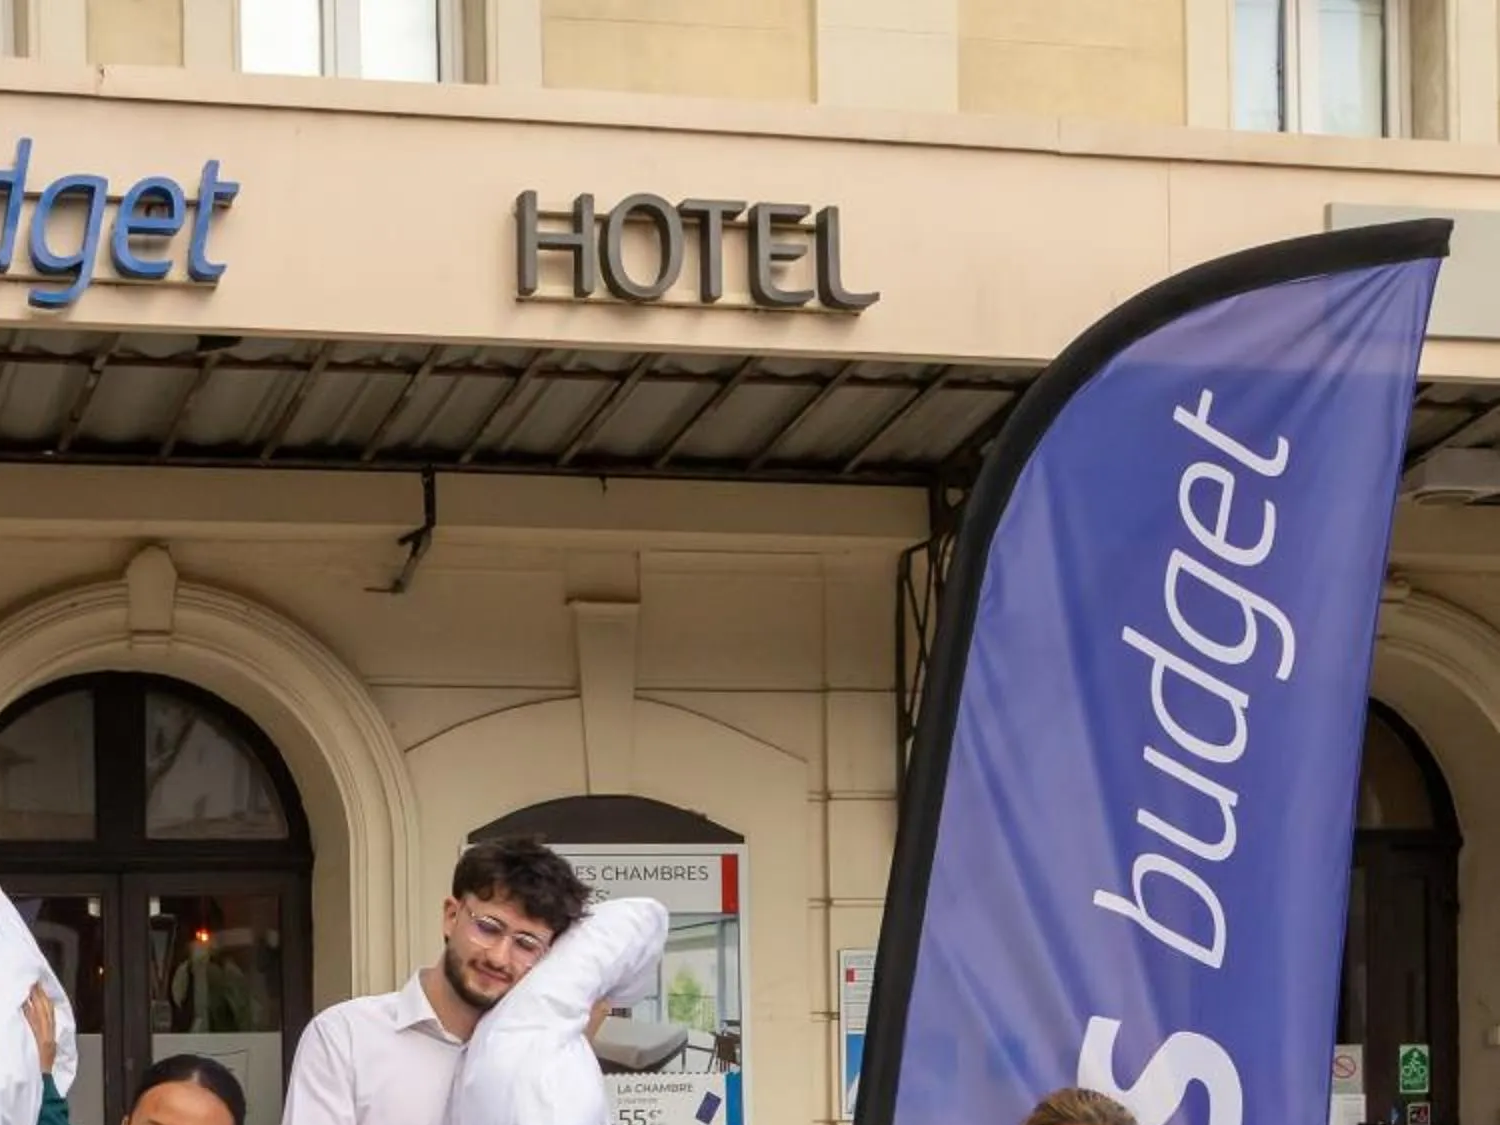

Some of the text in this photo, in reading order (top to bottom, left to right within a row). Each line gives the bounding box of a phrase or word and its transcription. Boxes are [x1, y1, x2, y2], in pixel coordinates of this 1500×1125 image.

[515, 189, 881, 311] HOTEL
[1093, 389, 1296, 970] budget
[601, 865, 709, 881] CHAMBRES
[635, 1083, 694, 1094] CHAMBRE
